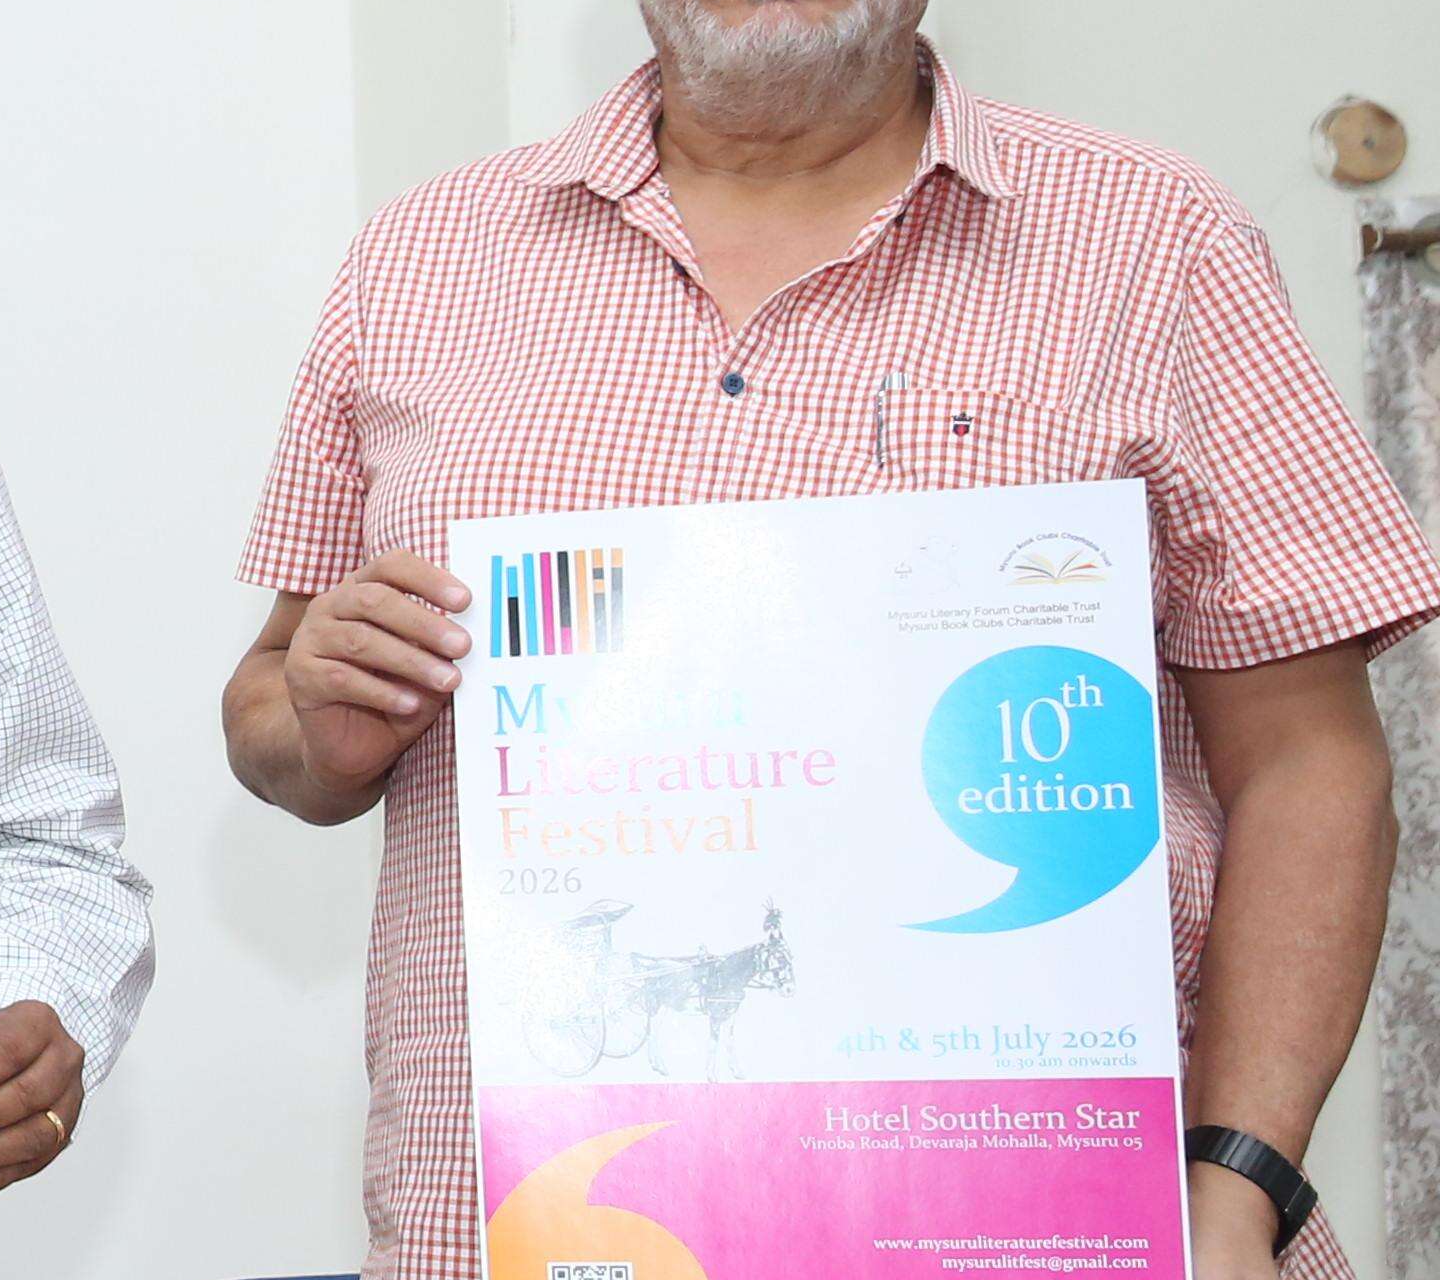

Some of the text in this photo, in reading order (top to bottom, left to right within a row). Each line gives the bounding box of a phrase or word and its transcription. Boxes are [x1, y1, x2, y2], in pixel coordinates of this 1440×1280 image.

[997, 675, 1104, 764] 10th
[496, 744, 836, 797] Literature
[958, 773, 1134, 814] edition
[499, 798, 759, 858] Festival
[499, 867, 582, 894] 2026
[825, 1104, 1140, 1132] Hotel Southern Star
[800, 1135, 1142, 1151] Vinoba Road, Devaraja Mohalla, Mysuru 05
[874, 1235, 1149, 1253] www.mysuruliteraturefestival.com
[942, 1255, 1147, 1272] mysurulitfest@gmail.com
